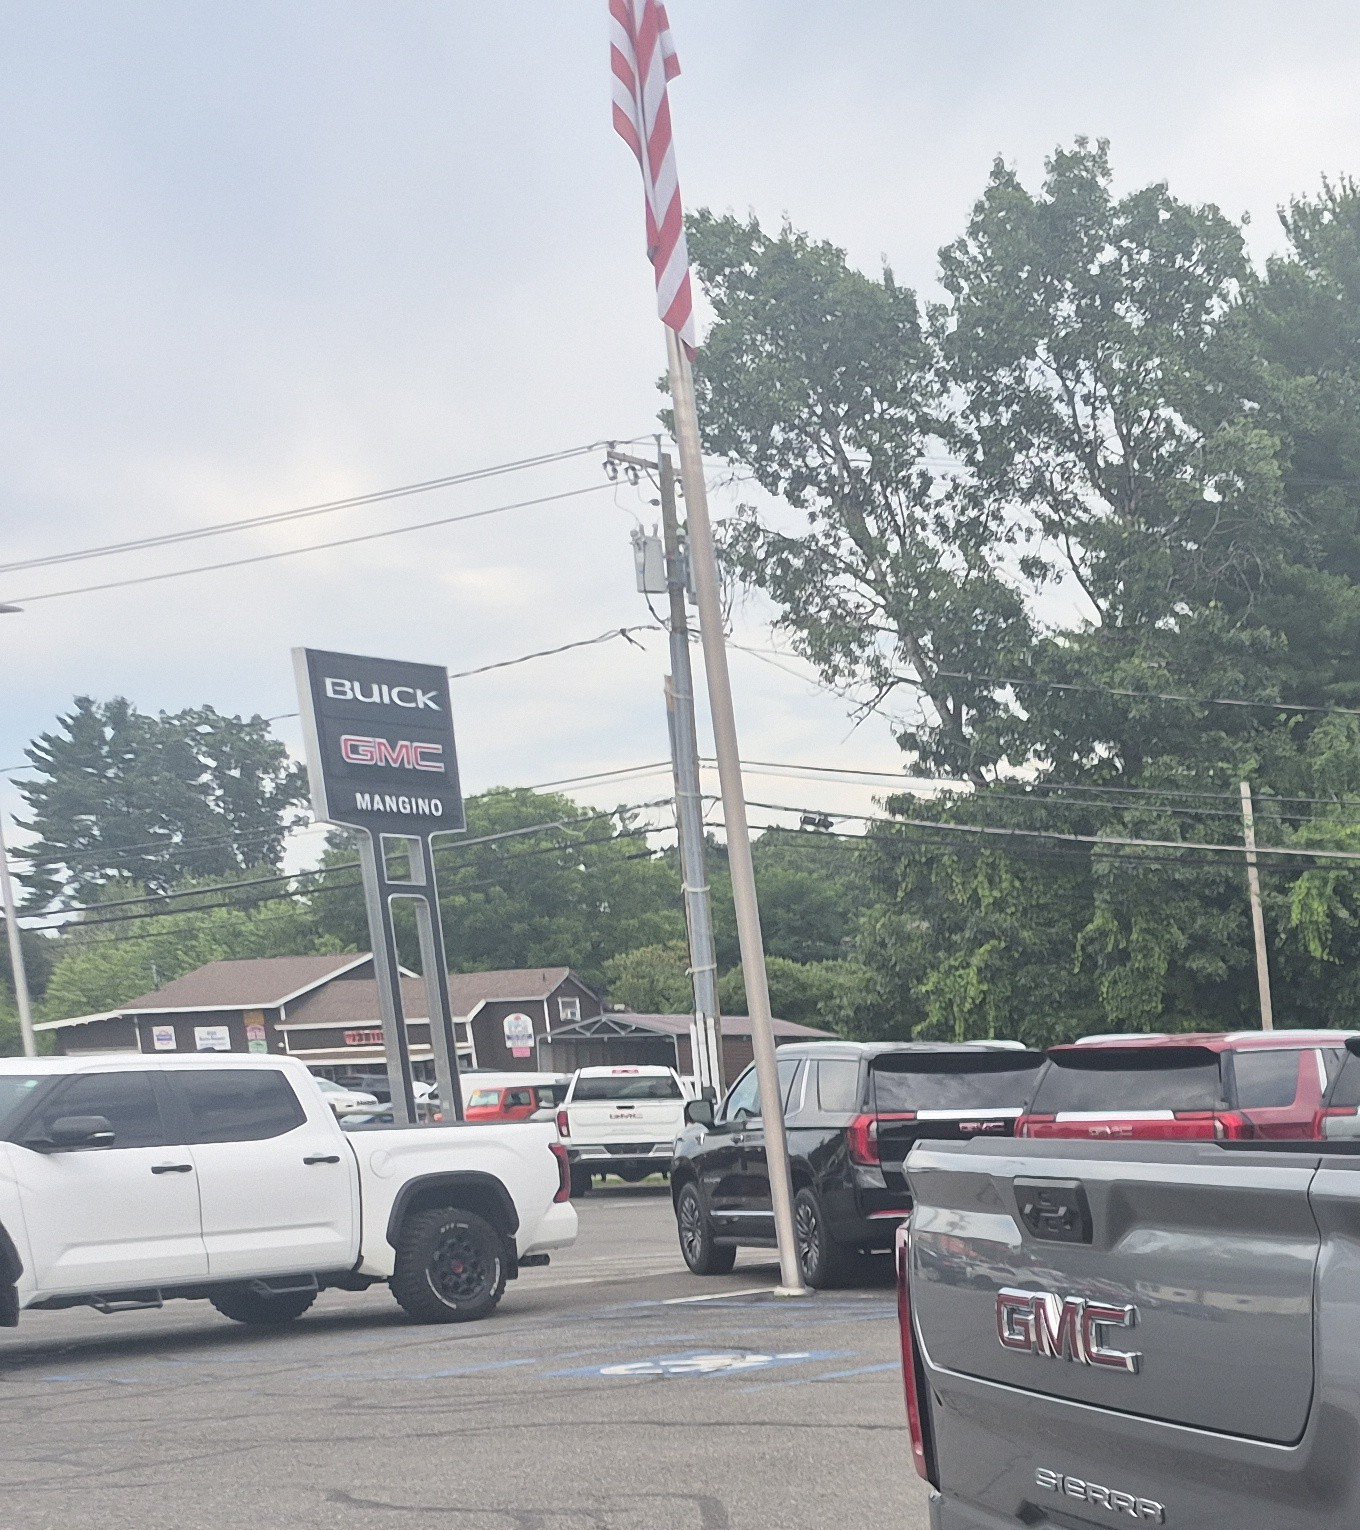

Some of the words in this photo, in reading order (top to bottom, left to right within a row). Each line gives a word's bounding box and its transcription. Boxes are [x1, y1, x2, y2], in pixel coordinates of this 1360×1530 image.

[324, 677, 443, 711] BUICK
[340, 734, 445, 773] GMC
[355, 791, 443, 817] MANGINO
[995, 1287, 1143, 1375] GMC
[1036, 1467, 1166, 1524] SIERRA
